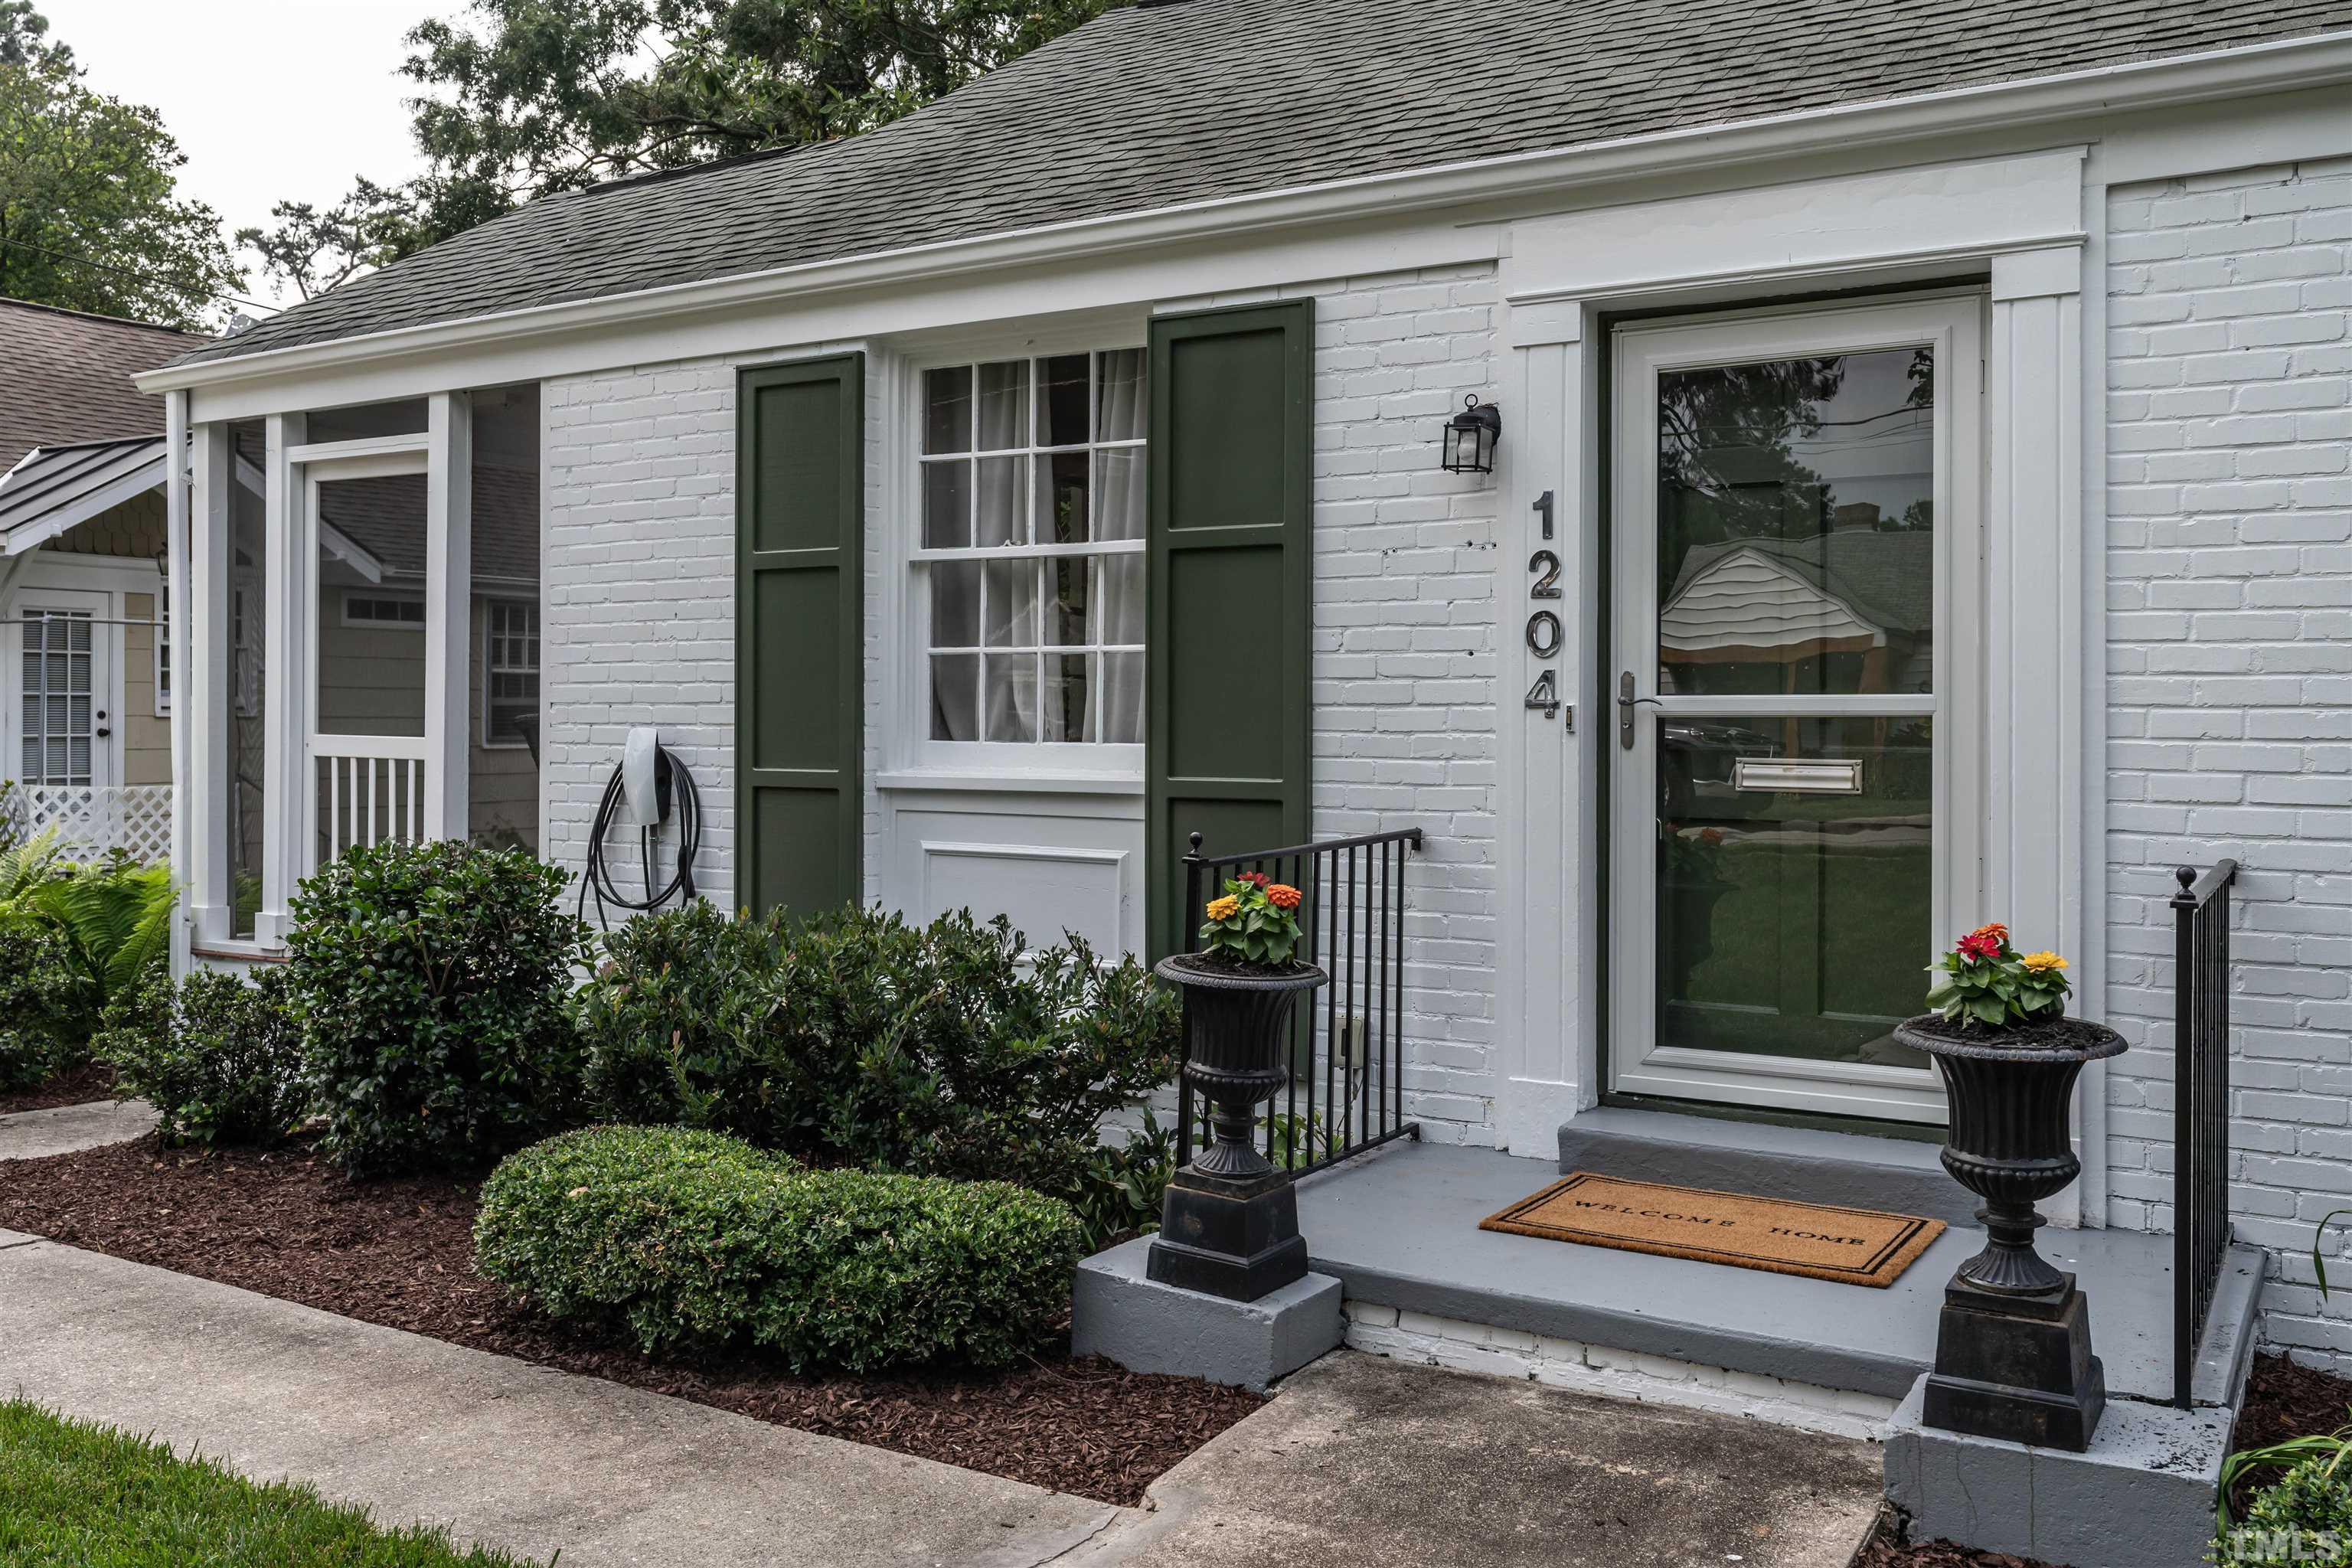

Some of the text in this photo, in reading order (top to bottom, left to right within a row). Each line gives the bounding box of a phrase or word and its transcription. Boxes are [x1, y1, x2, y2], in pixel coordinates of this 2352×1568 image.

[1525, 489, 1562, 718] 1204
[1575, 1200, 1866, 1245] WELCOME HOME
